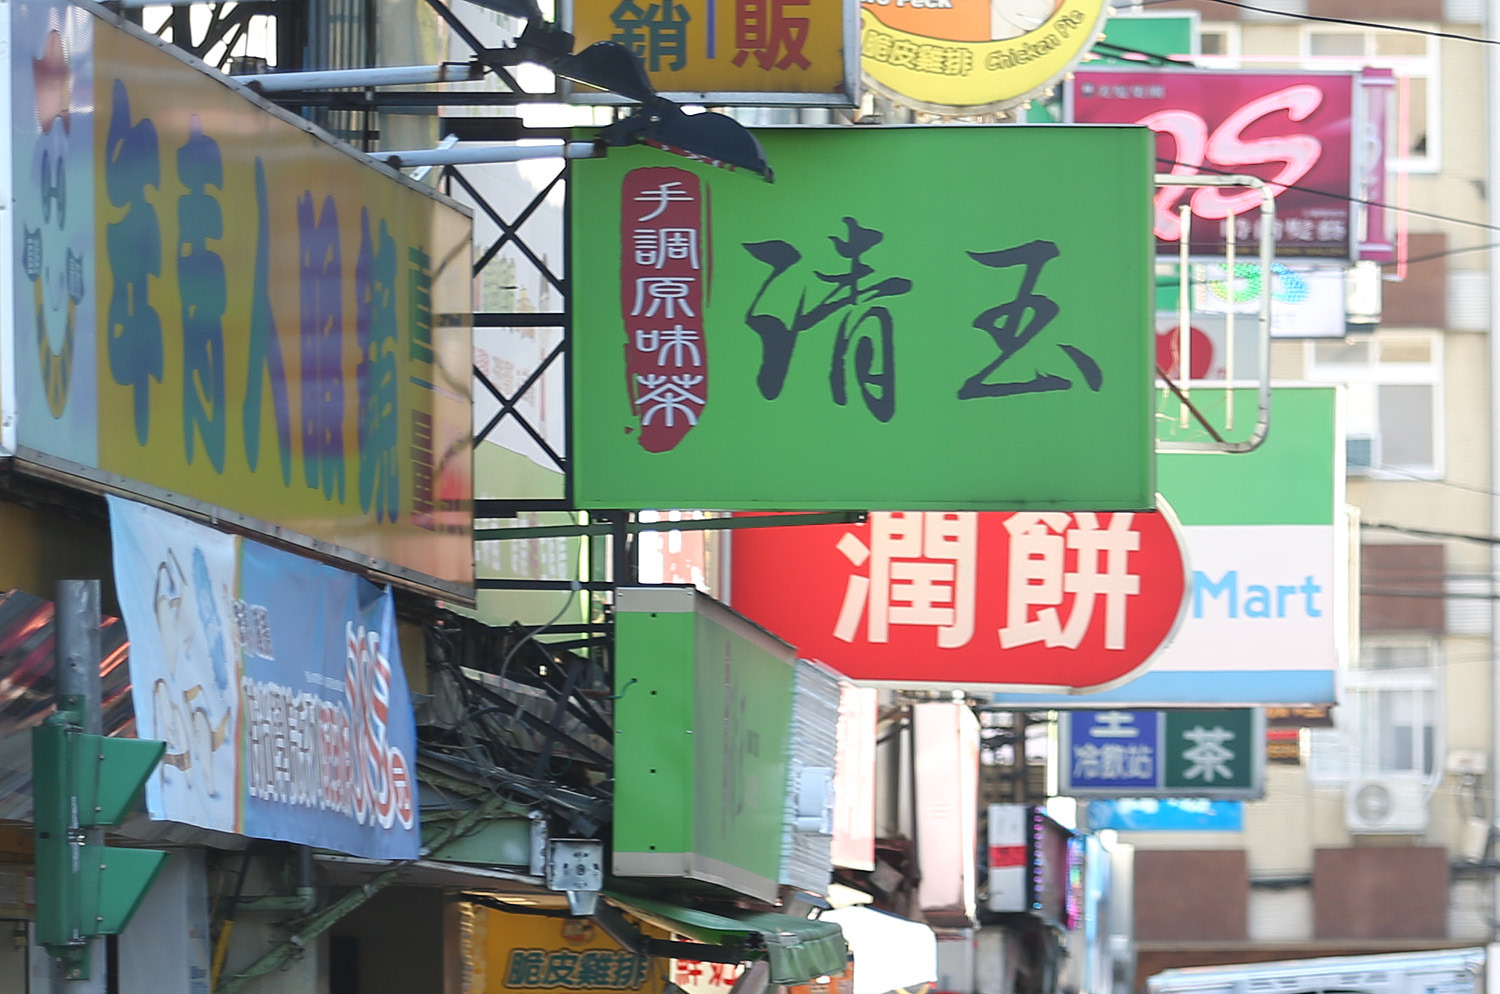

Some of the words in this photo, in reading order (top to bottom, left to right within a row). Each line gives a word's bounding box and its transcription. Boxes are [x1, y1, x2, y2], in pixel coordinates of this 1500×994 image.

[610, 0, 690, 72] 銷
[732, 0, 811, 71] 販
[630, 180, 705, 427] 手調原味茶
[832, 511, 1142, 651] 潤餅
[1191, 570, 1321, 619] Mart
[1182, 727, 1236, 782] 茶
[505, 949, 650, 989] 脆皮雞排
